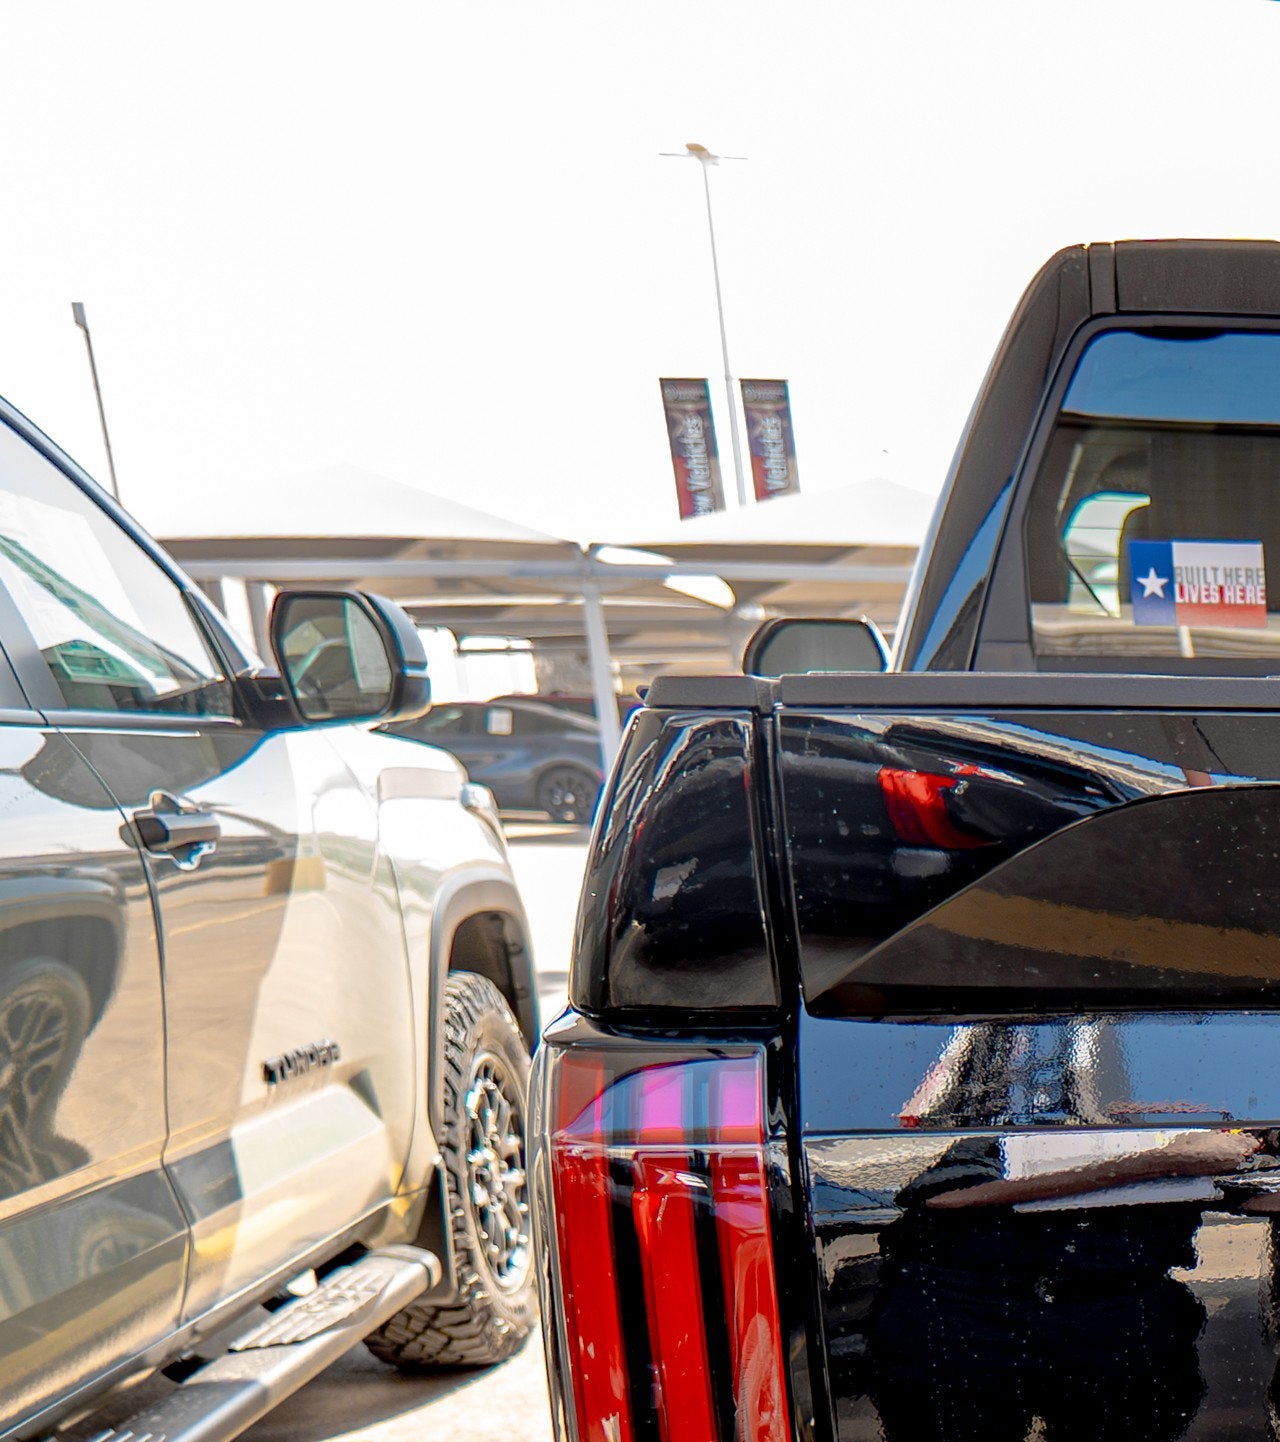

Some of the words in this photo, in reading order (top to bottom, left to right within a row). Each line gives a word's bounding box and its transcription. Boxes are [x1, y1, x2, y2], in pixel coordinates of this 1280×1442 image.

[1174, 566, 1219, 584] BUILT
[1223, 567, 1265, 586] HERE
[1174, 584, 1220, 604] LIVES
[1223, 585, 1266, 605] HERE
